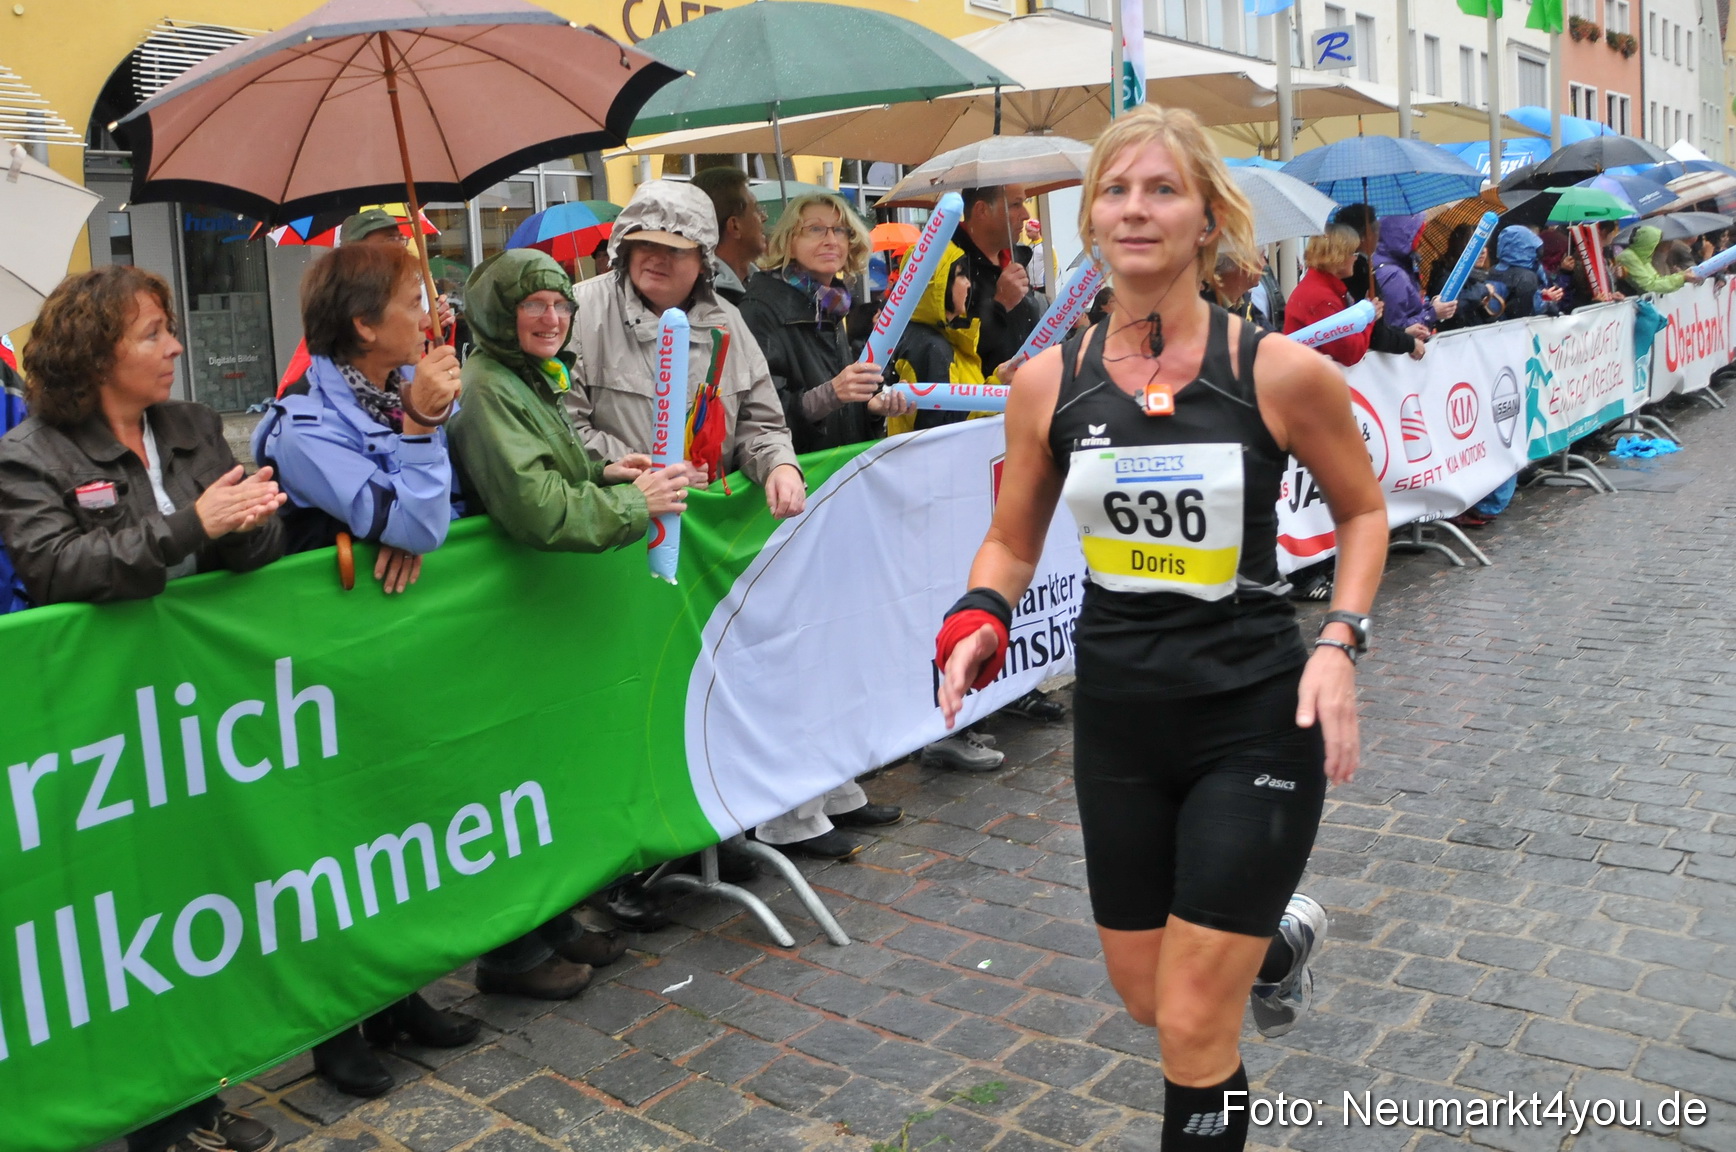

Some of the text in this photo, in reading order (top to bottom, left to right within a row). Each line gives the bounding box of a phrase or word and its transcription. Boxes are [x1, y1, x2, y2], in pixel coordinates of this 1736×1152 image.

[874, 208, 946, 335] TUI ReiseCenter
[1030, 327, 1054, 349] TUI
[1665, 298, 1725, 373] Oberbank
[652, 324, 675, 464] ReiseCenter
[949, 384, 977, 396] TUI
[1450, 394, 1475, 429] KIA
[1494, 398, 1520, 417] SSAN
[1081, 437, 1112, 446] erima
[1115, 455, 1185, 473] BOCK
[1445, 440, 1487, 476] KIA MOTORS
[1390, 465, 1443, 493] SEAT
[1103, 488, 1207, 543] 636
[1131, 549, 1186, 575] Doris
[7, 656, 339, 852] rzlich
[1268, 778, 1296, 790] asics
[0, 780, 553, 1062] llkommen
